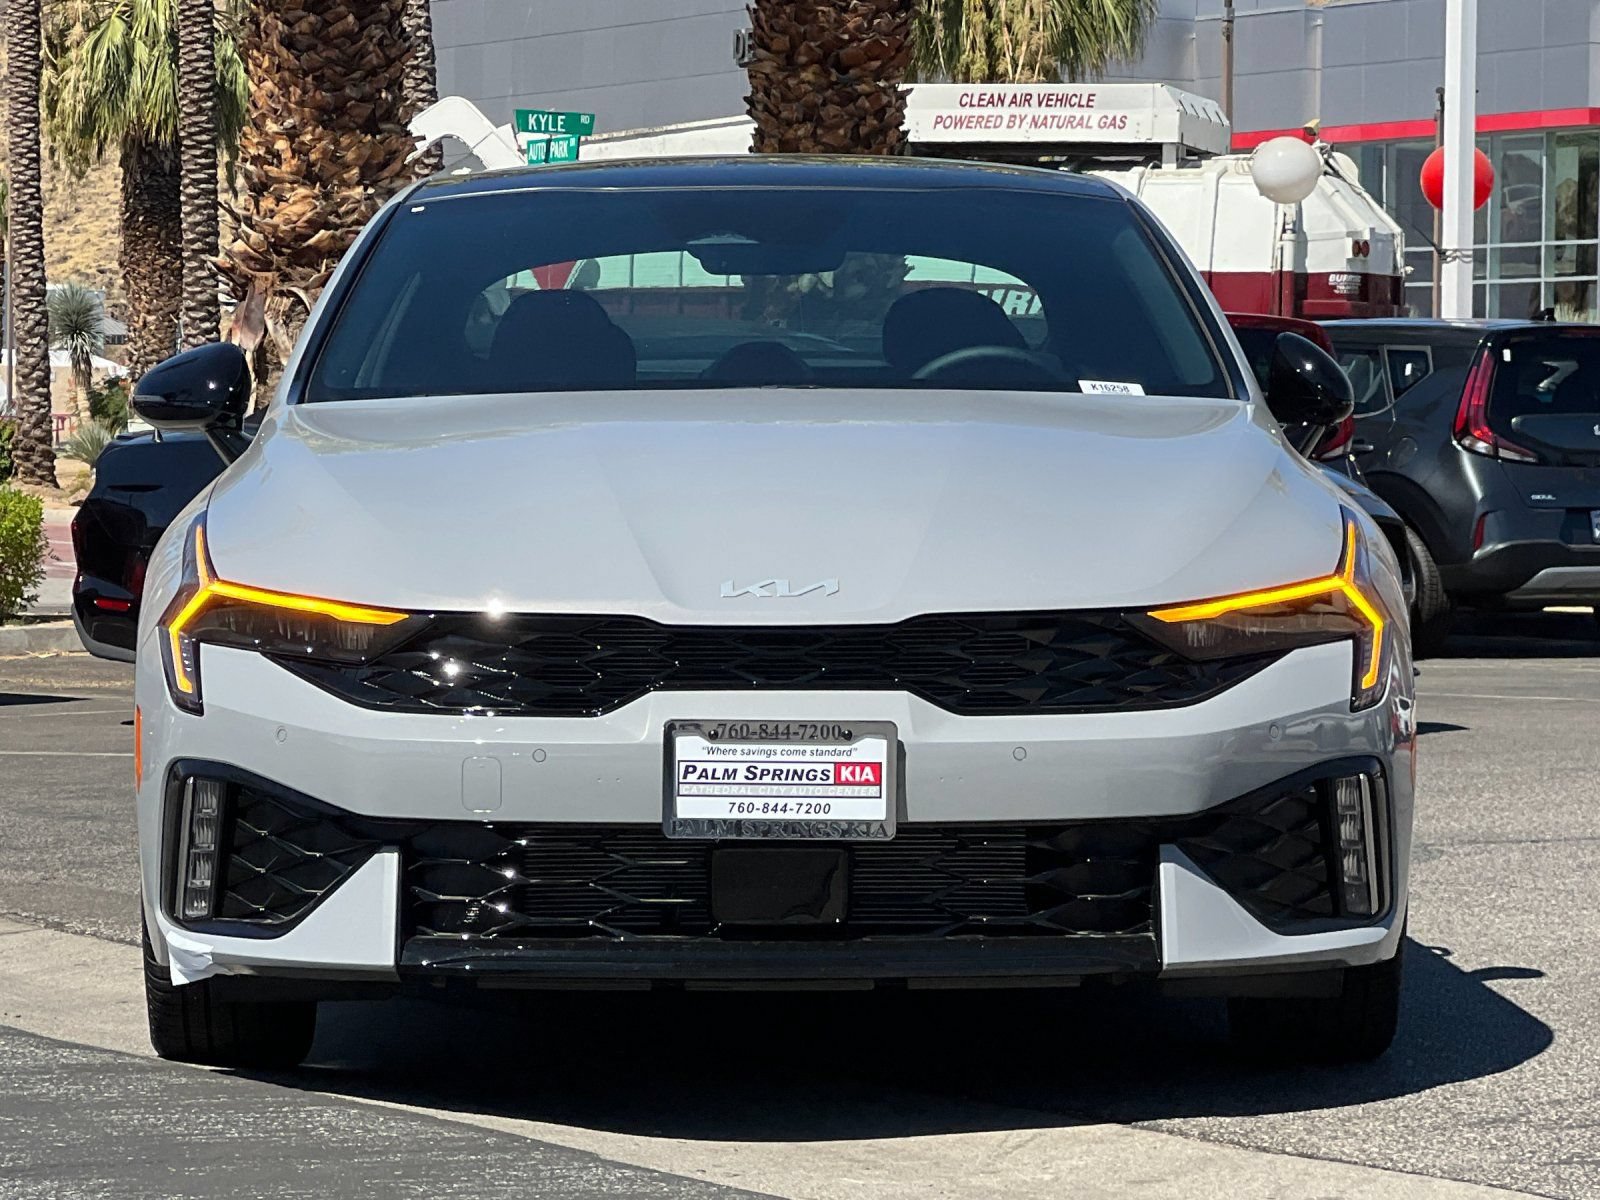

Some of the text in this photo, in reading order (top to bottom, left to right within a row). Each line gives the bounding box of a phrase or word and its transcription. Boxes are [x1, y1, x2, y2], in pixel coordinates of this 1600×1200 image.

[959, 93, 1096, 108] CLEAN AIR VEHICLE
[528, 113, 590, 132] KYLE RD
[933, 114, 1128, 130] POWERED BY NATURAL GAS
[528, 142, 546, 160] AUTO
[549, 140, 568, 158] PARK
[1090, 383, 1130, 393] K16258
[717, 723, 841, 740] 760-844-7200
[740, 746, 778, 759] savings
[780, 748, 807, 758] come
[682, 764, 875, 782] PALM SPRINGS KIA
[681, 785, 876, 796] CATHEDRAL CITY AUTO CENTER
[728, 802, 831, 815] 760-844-7200
[670, 819, 889, 838] PALM SPRINGS KIA
